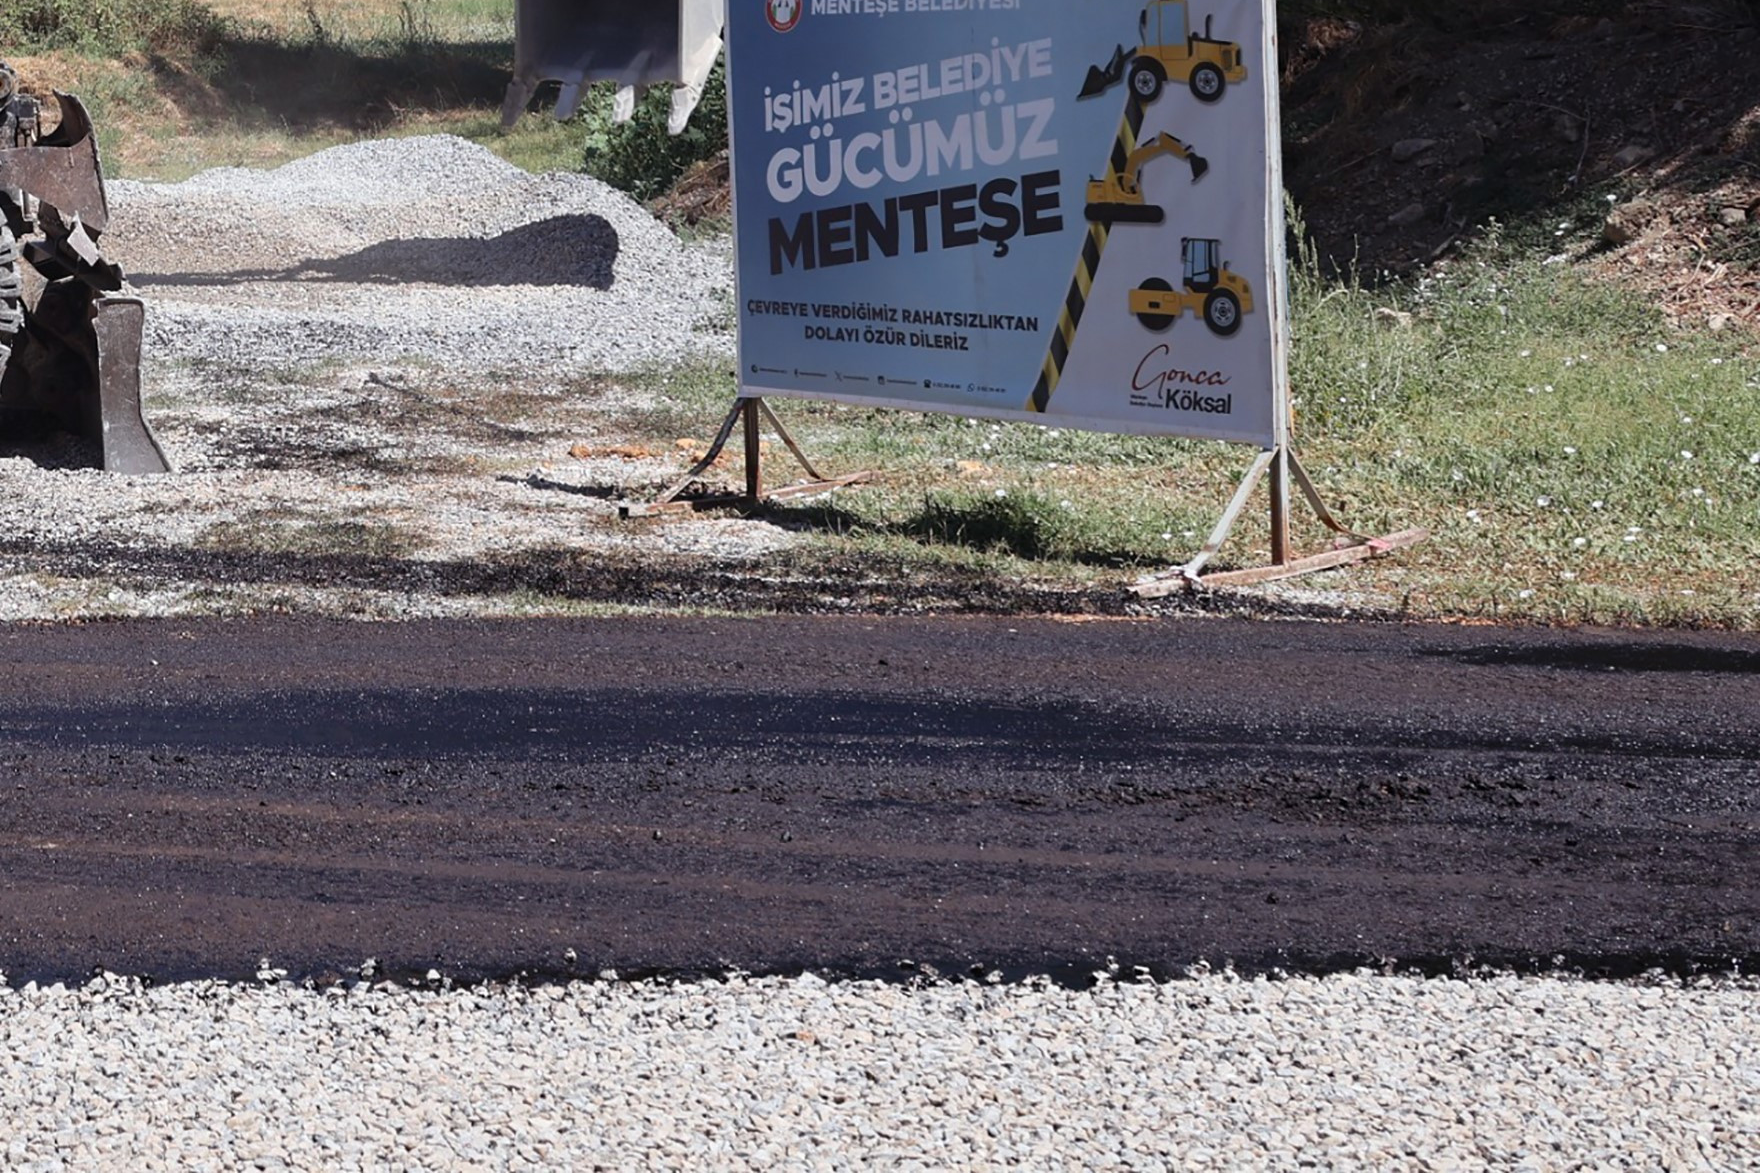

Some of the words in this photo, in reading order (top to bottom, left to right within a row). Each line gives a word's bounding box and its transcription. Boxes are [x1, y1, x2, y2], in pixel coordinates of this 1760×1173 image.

[764, 70, 865, 134] İŞİMİZ
[873, 36, 1053, 110] BELEDİYE
[766, 88, 1059, 203] GÜCÜMÜZ
[768, 169, 1064, 275] MENTEŞE
[747, 299, 808, 316] ÇEVREYE
[811, 301, 898, 323] VERDİĞİMİZ
[902, 309, 1038, 332] RAHATSIZLIKTAN
[804, 325, 859, 343] DOLAYI
[864, 325, 906, 346] ÖZÜR
[910, 331, 969, 351] DİLERİZ
[1132, 343, 1232, 400] Gonca
[1165, 388, 1232, 415] Köksal
